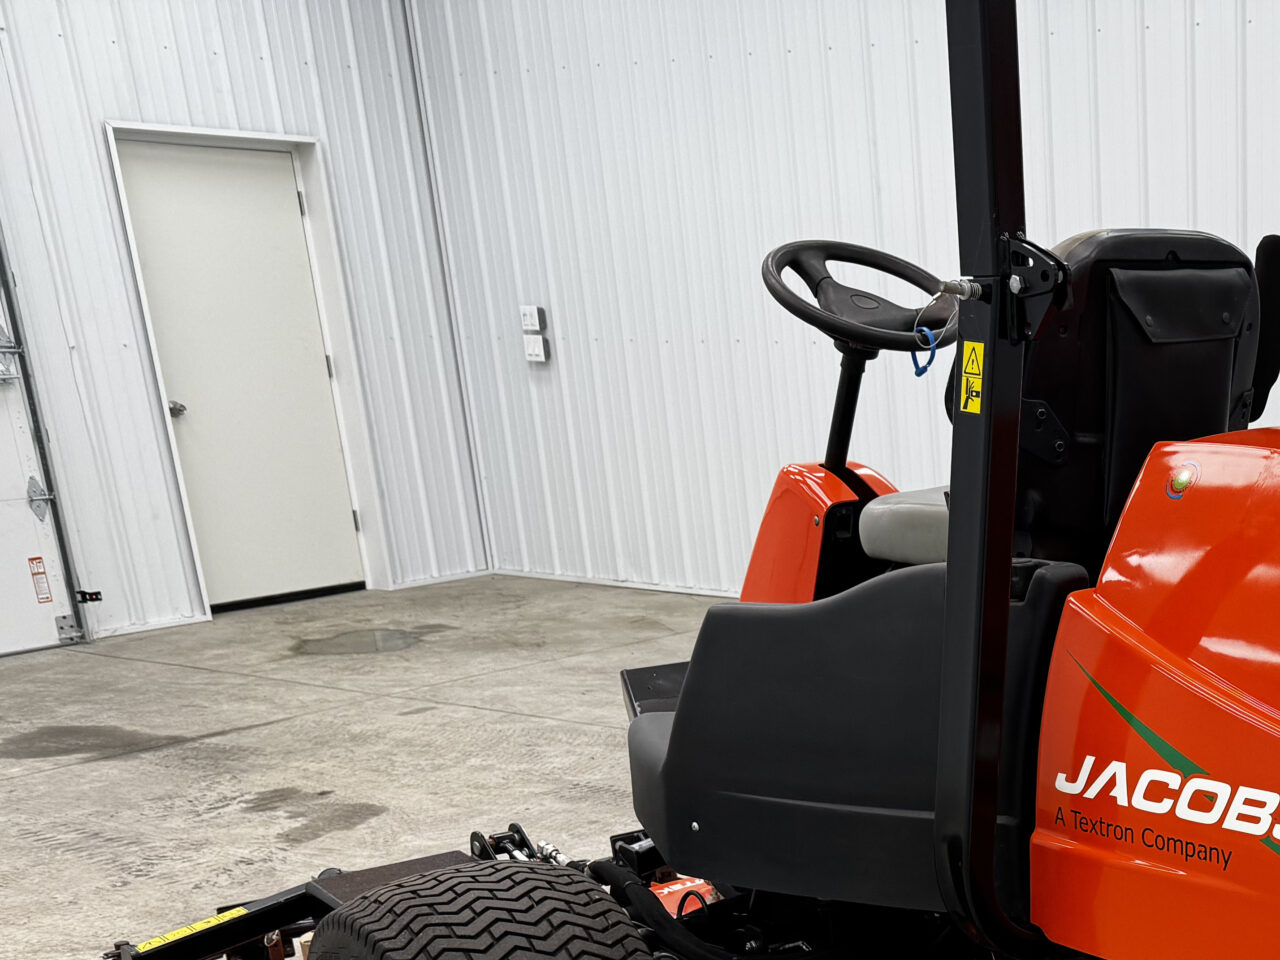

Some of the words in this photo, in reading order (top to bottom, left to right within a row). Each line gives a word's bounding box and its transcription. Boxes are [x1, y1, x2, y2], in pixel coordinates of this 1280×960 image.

[1054, 807, 1066, 827] A
[1070, 810, 1135, 844] Textron
[1142, 827, 1233, 872] Company
